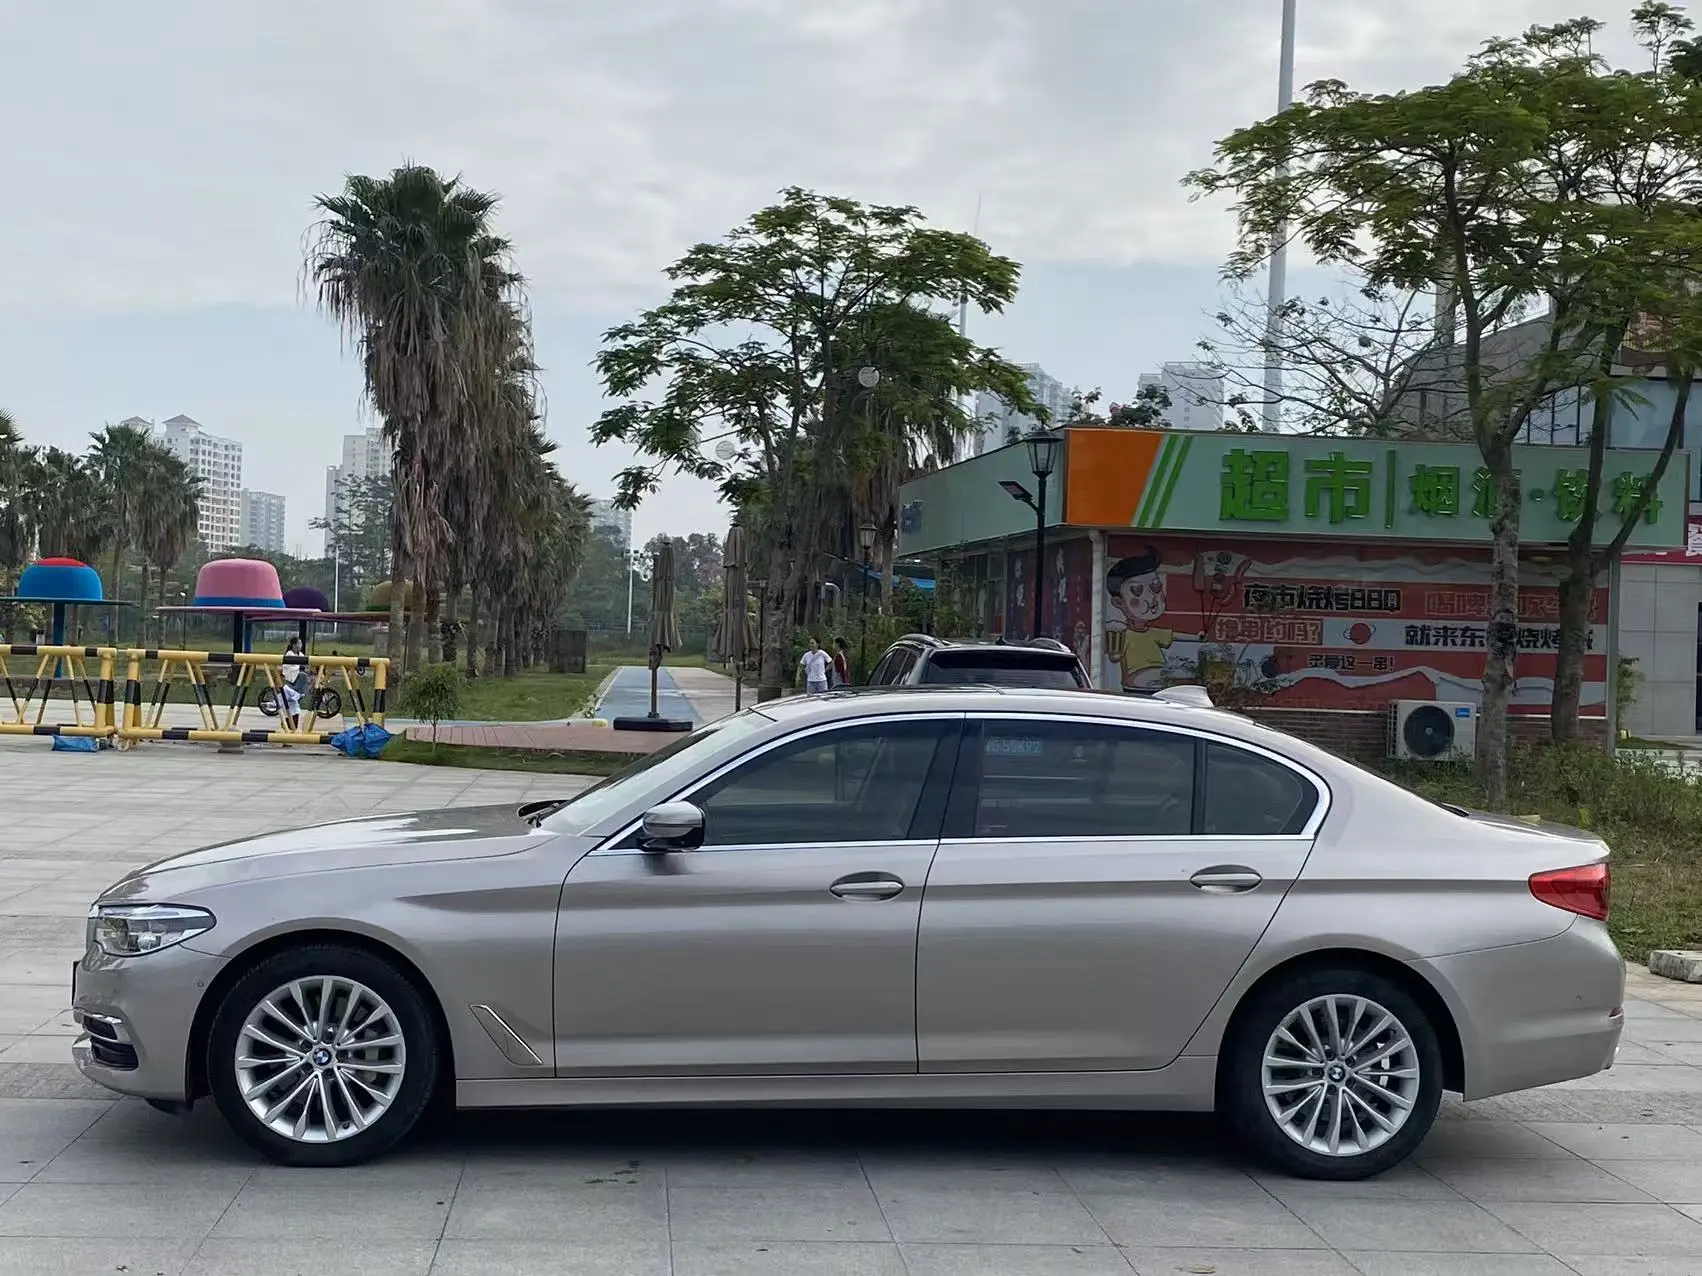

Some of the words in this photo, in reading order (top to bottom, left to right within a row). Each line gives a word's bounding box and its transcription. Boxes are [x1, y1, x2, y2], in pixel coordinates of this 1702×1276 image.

[1220, 449, 1373, 525] 超市
[1405, 623, 1594, 650] 就来东烧烤
